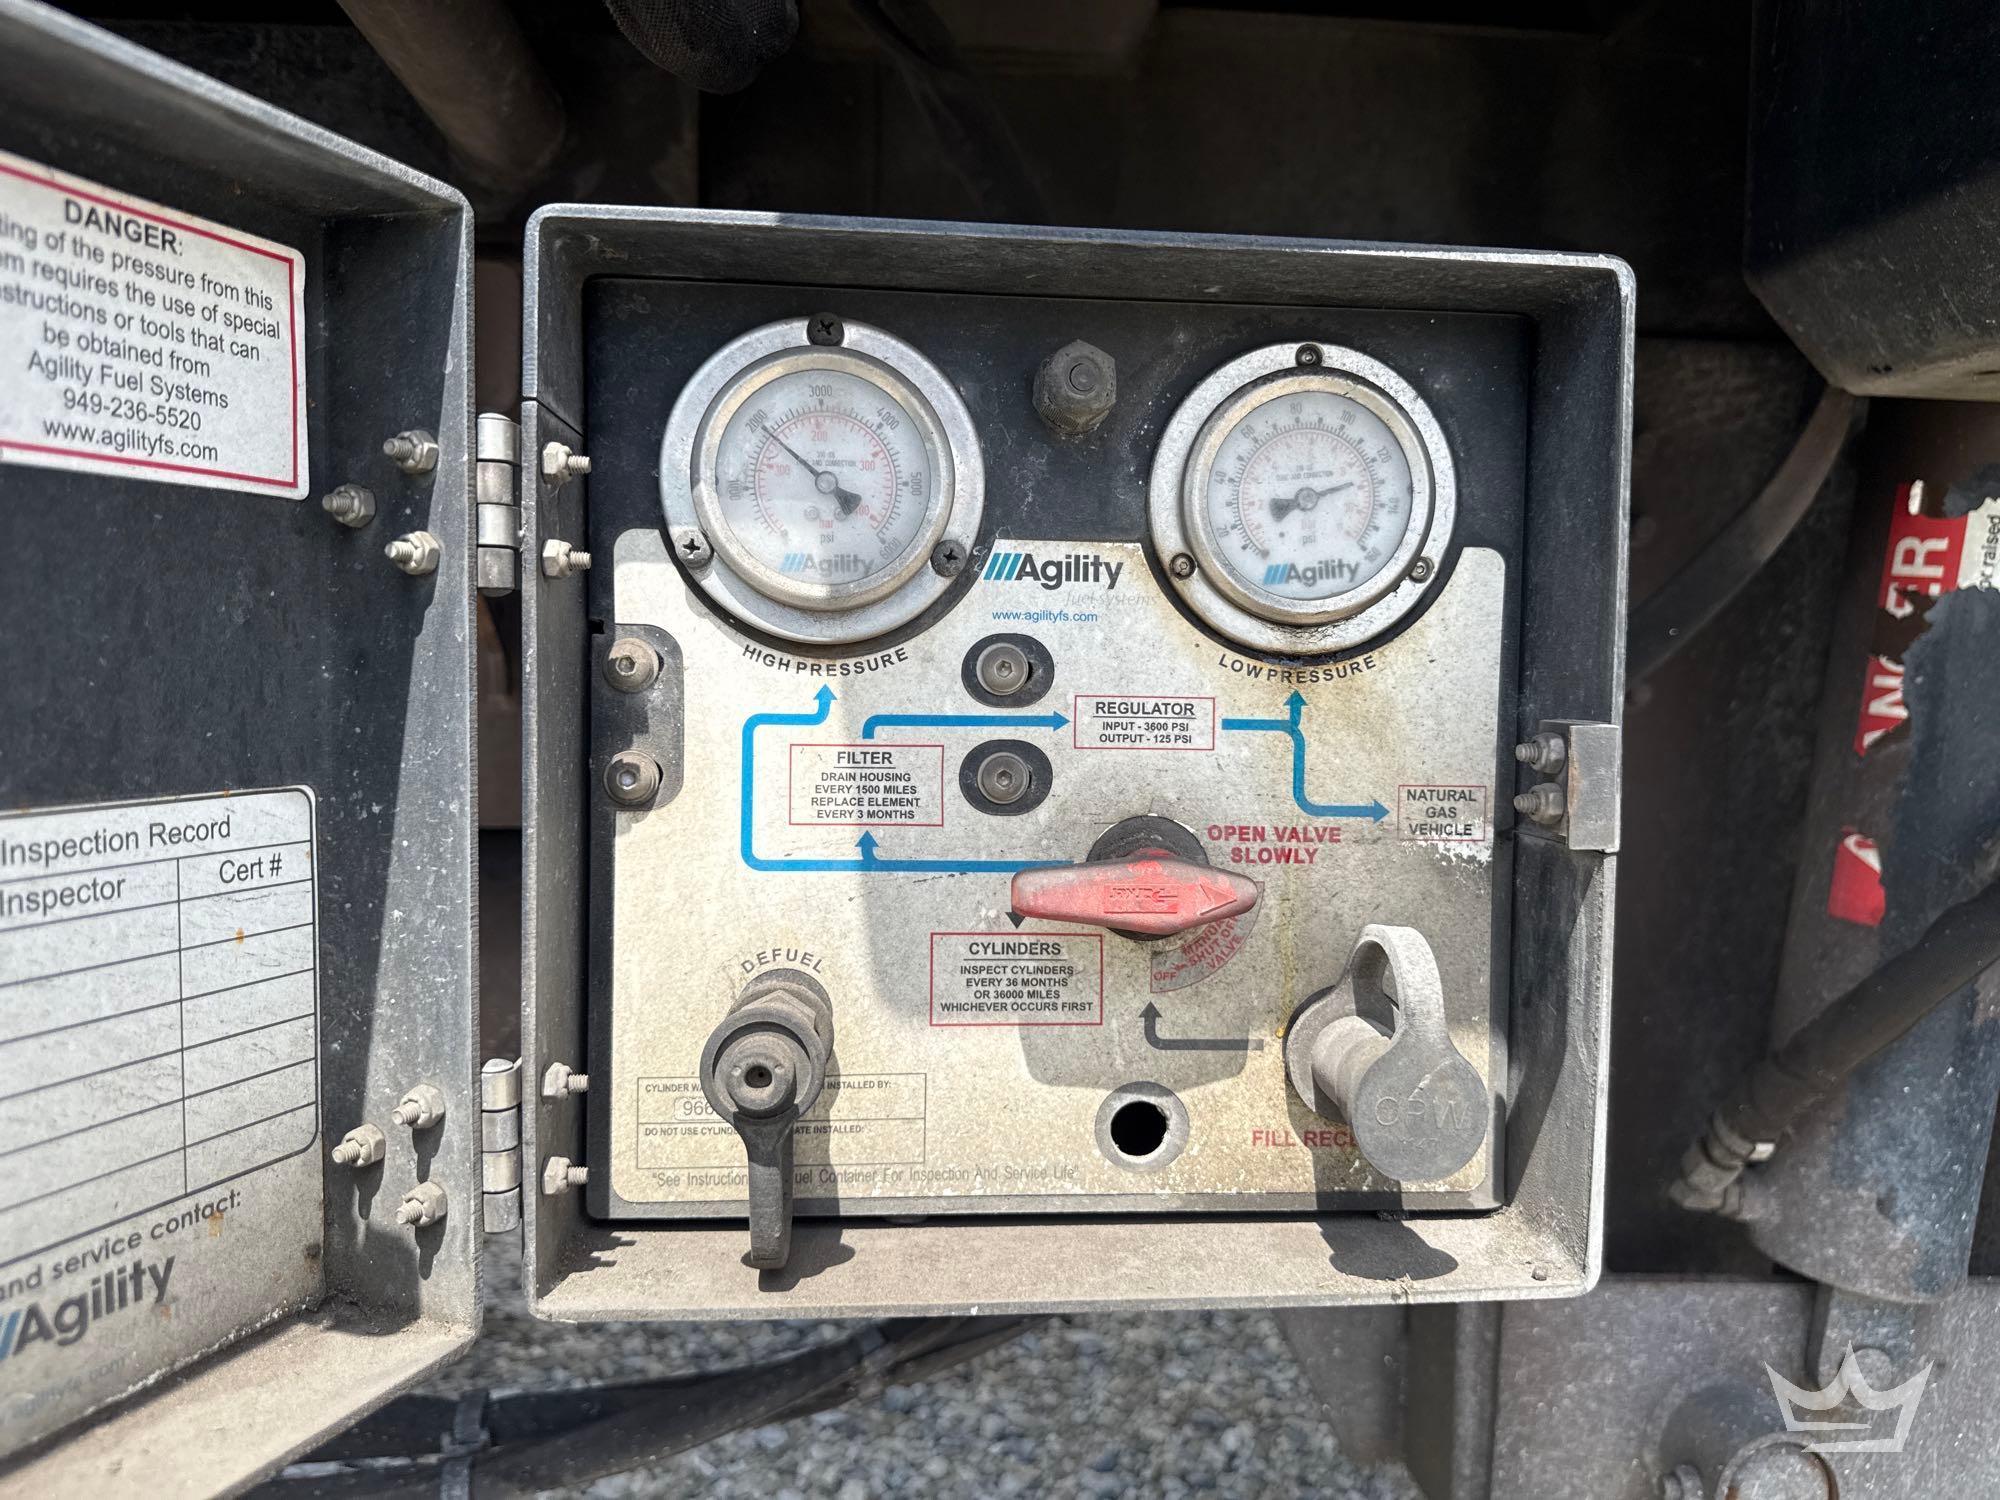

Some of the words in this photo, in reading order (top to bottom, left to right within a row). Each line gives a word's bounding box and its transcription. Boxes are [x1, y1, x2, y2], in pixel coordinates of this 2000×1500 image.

[65, 199, 183, 256] DANGER:
[45, 230, 65, 253] of
[72, 235, 104, 264] the
[112, 252, 195, 289] pressure
[201, 273, 239, 302] from
[245, 286, 273, 311] this
[32, 258, 119, 298] requires
[126, 281, 155, 306] the
[163, 293, 195, 320] use
[202, 303, 220, 323] of
[223, 311, 281, 339] special
[0, 283, 107, 325] structions
[114, 312, 134, 330] or
[141, 318, 185, 342] tools
[191, 328, 225, 353] that
[231, 341, 260, 361] can
[43, 321, 70, 347] be
[78, 330, 163, 367] obtained
[169, 351, 210, 377] from
[28, 350, 93, 387] Agility
[101, 364, 143, 392] Fuel
[151, 376, 229, 409] Systems
[809, 384, 833, 397] 3000
[64, 388, 202, 431] 949-236-5520
[745, 409, 768, 433] 2000
[877, 407, 900, 431] 4000
[44, 419, 218, 462] www.agilityfs.com
[811, 430, 828, 442] 200
[1376, 445, 1392, 464] 120
[859, 460, 875, 472] 300
[910, 471, 922, 497] 5000
[820, 533, 834, 544] psi
[802, 553, 874, 577] Agility
[1014, 553, 1124, 590] Agility
[1285, 558, 1360, 587] Agility
[992, 609, 1098, 624] www.agilityfs.com
[742, 644, 790, 672] HIGH
[796, 647, 909, 677] PRESSURE
[1218, 654, 1263, 679] LOW
[1267, 655, 1377, 684] PRESSURE
[1095, 701, 1195, 716] REGULATOR
[1102, 721, 1135, 731] INPUT
[1144, 721, 1169, 732] 3600
[1171, 722, 1189, 732] PSI
[1099, 734, 1144, 744] OUTPUT
[1153, 734, 1171, 744] 125
[1174, 734, 1192, 744] PSI
[837, 752, 892, 764] FILTER
[821, 773, 856, 782] DRAIN
[859, 772, 911, 782] HOUSING
[815, 785, 853, 794] EVERY
[856, 785, 880, 794] 1500
[883, 785, 917, 794] MILES
[1406, 789, 1477, 802] NATURAL
[811, 797, 865, 807] REPLACE
[867, 797, 920, 807] ELEMENT
[817, 810, 855, 819] EVERY
[857, 810, 864, 819] 3
[866, 810, 915, 819] MONTHS
[1425, 806, 1457, 818] GAS
[1207, 824, 1266, 843] OPEN
[1273, 826, 1342, 843] VALVE
[1408, 823, 1473, 836] VEHICLE
[2, 828, 139, 867] Inspection
[150, 815, 231, 847] Record
[1230, 846, 1319, 865] SLOWLY
[219, 856, 264, 884] Cert
[269, 853, 283, 878] #
[0, 877, 126, 916] Inspector
[969, 942, 1061, 956] CYLINDERS
[740, 948, 825, 974] DEFUEL
[960, 966, 1008, 975] INSPECT
[1011, 966, 1074, 975] CYLINDERS
[1153, 971, 1177, 981] OFF
[966, 978, 1003, 987] EVERY
[1005, 978, 1018, 987] 36
[1021, 978, 1068, 987] MONTHS
[974, 990, 990, 999] OR
[993, 990, 1024, 999] 36000
[1027, 990, 1060, 999] MILES
[940, 1002, 1008, 1011] WHICHEVER
[1009, 1002, 1058, 1011] OCCURS
[1061, 1002, 1093, 1011] FIRST
[645, 1083, 689, 1092] CYLINDER
[827, 1081, 875, 1089] INSTALLED
[878, 1080, 892, 1089] BY:
[645, 1127, 658, 1136] DO
[660, 1127, 679, 1136] NOT
[681, 1127, 698, 1136] USE
[701, 1126, 738, 1136] CYLIND
[795, 1126, 812, 1134] ATE
[813, 1125, 865, 1133] INSTALLED:
[1252, 1130, 1296, 1147] FILL
[794, 1169, 812, 1184] uel
[819, 1168, 877, 1184] Container
[883, 1167, 905, 1182] For
[909, 1167, 969, 1184] Inspection
[975, 1167, 997, 1181] And
[1004, 1166, 1047, 1181] Service
[53, 1231, 142, 1280] service
[151, 1189, 241, 1240] contact:
[13, 1255, 175, 1357] Agility
